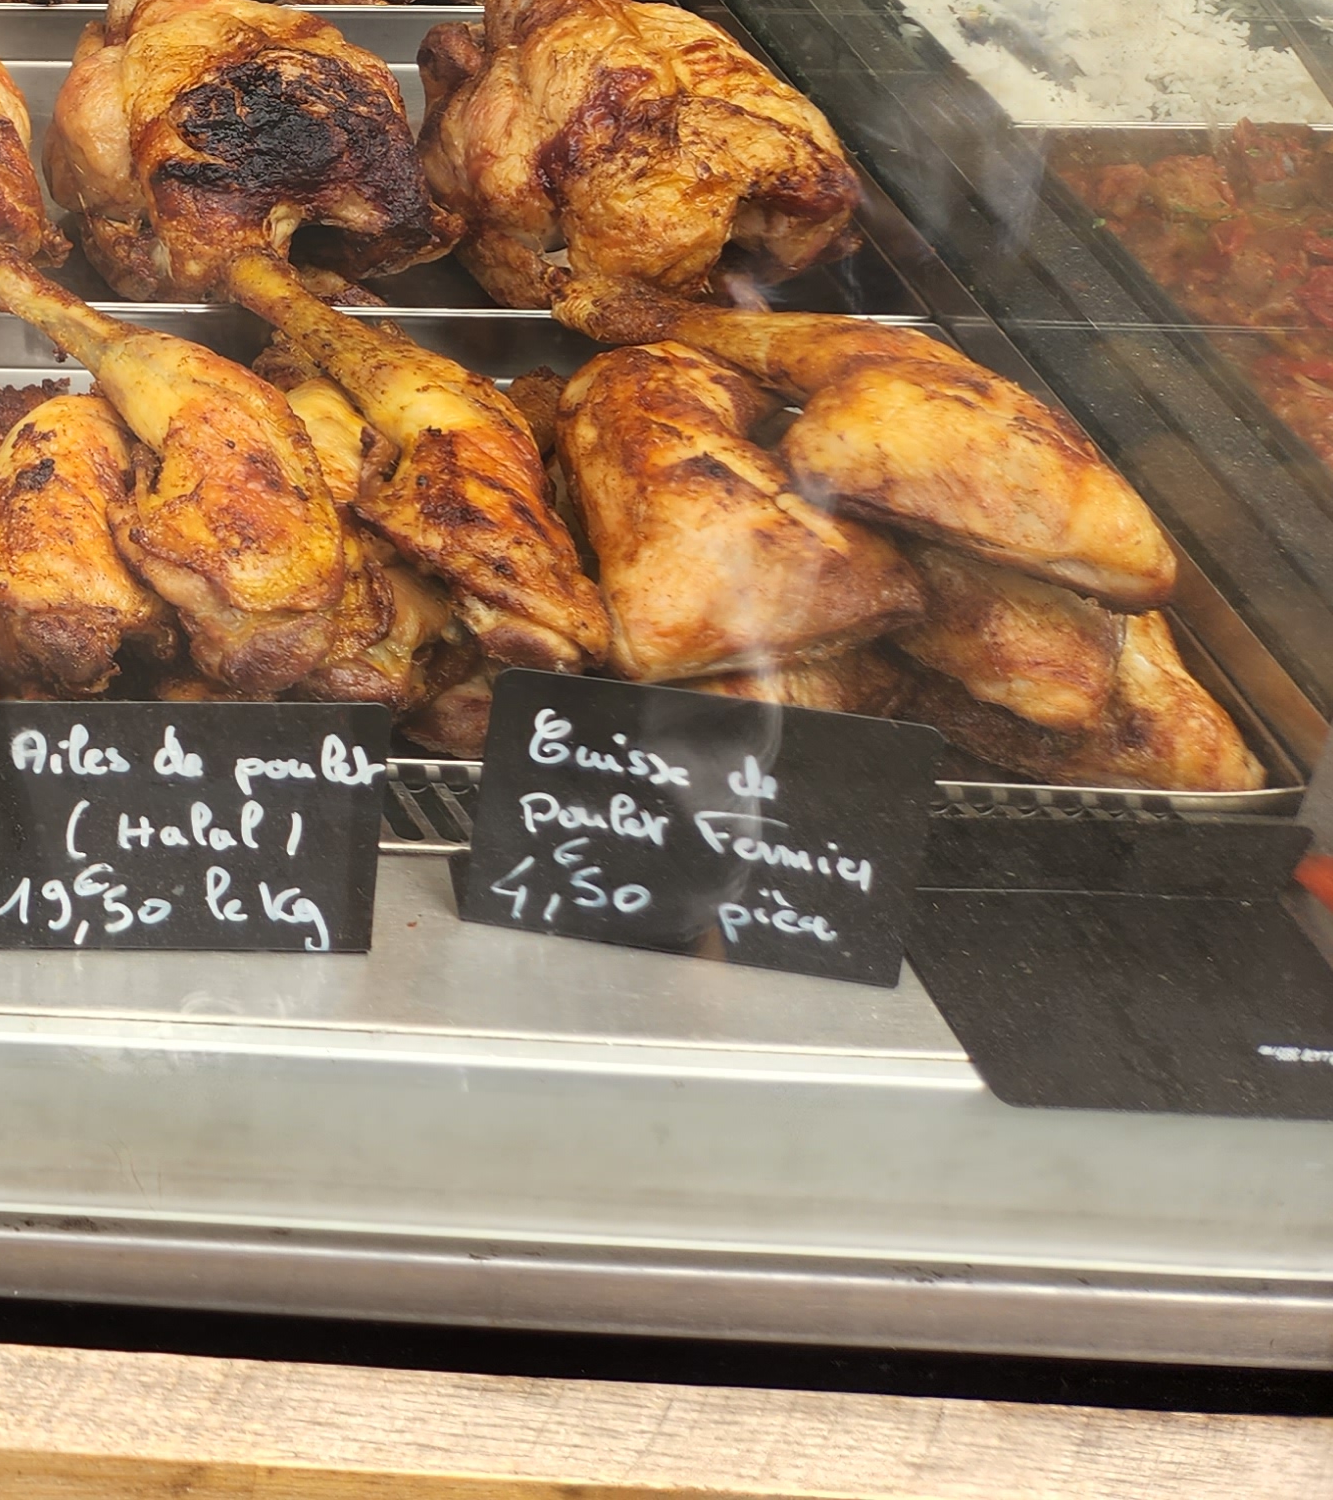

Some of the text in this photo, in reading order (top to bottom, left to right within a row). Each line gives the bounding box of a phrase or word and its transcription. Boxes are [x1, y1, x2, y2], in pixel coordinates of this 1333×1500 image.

[11, 723, 386, 795] Ailes de poulet
[529, 708, 778, 800] Cuisse de
[519, 791, 669, 847] Poulet
[205, 866, 249, 922] le
